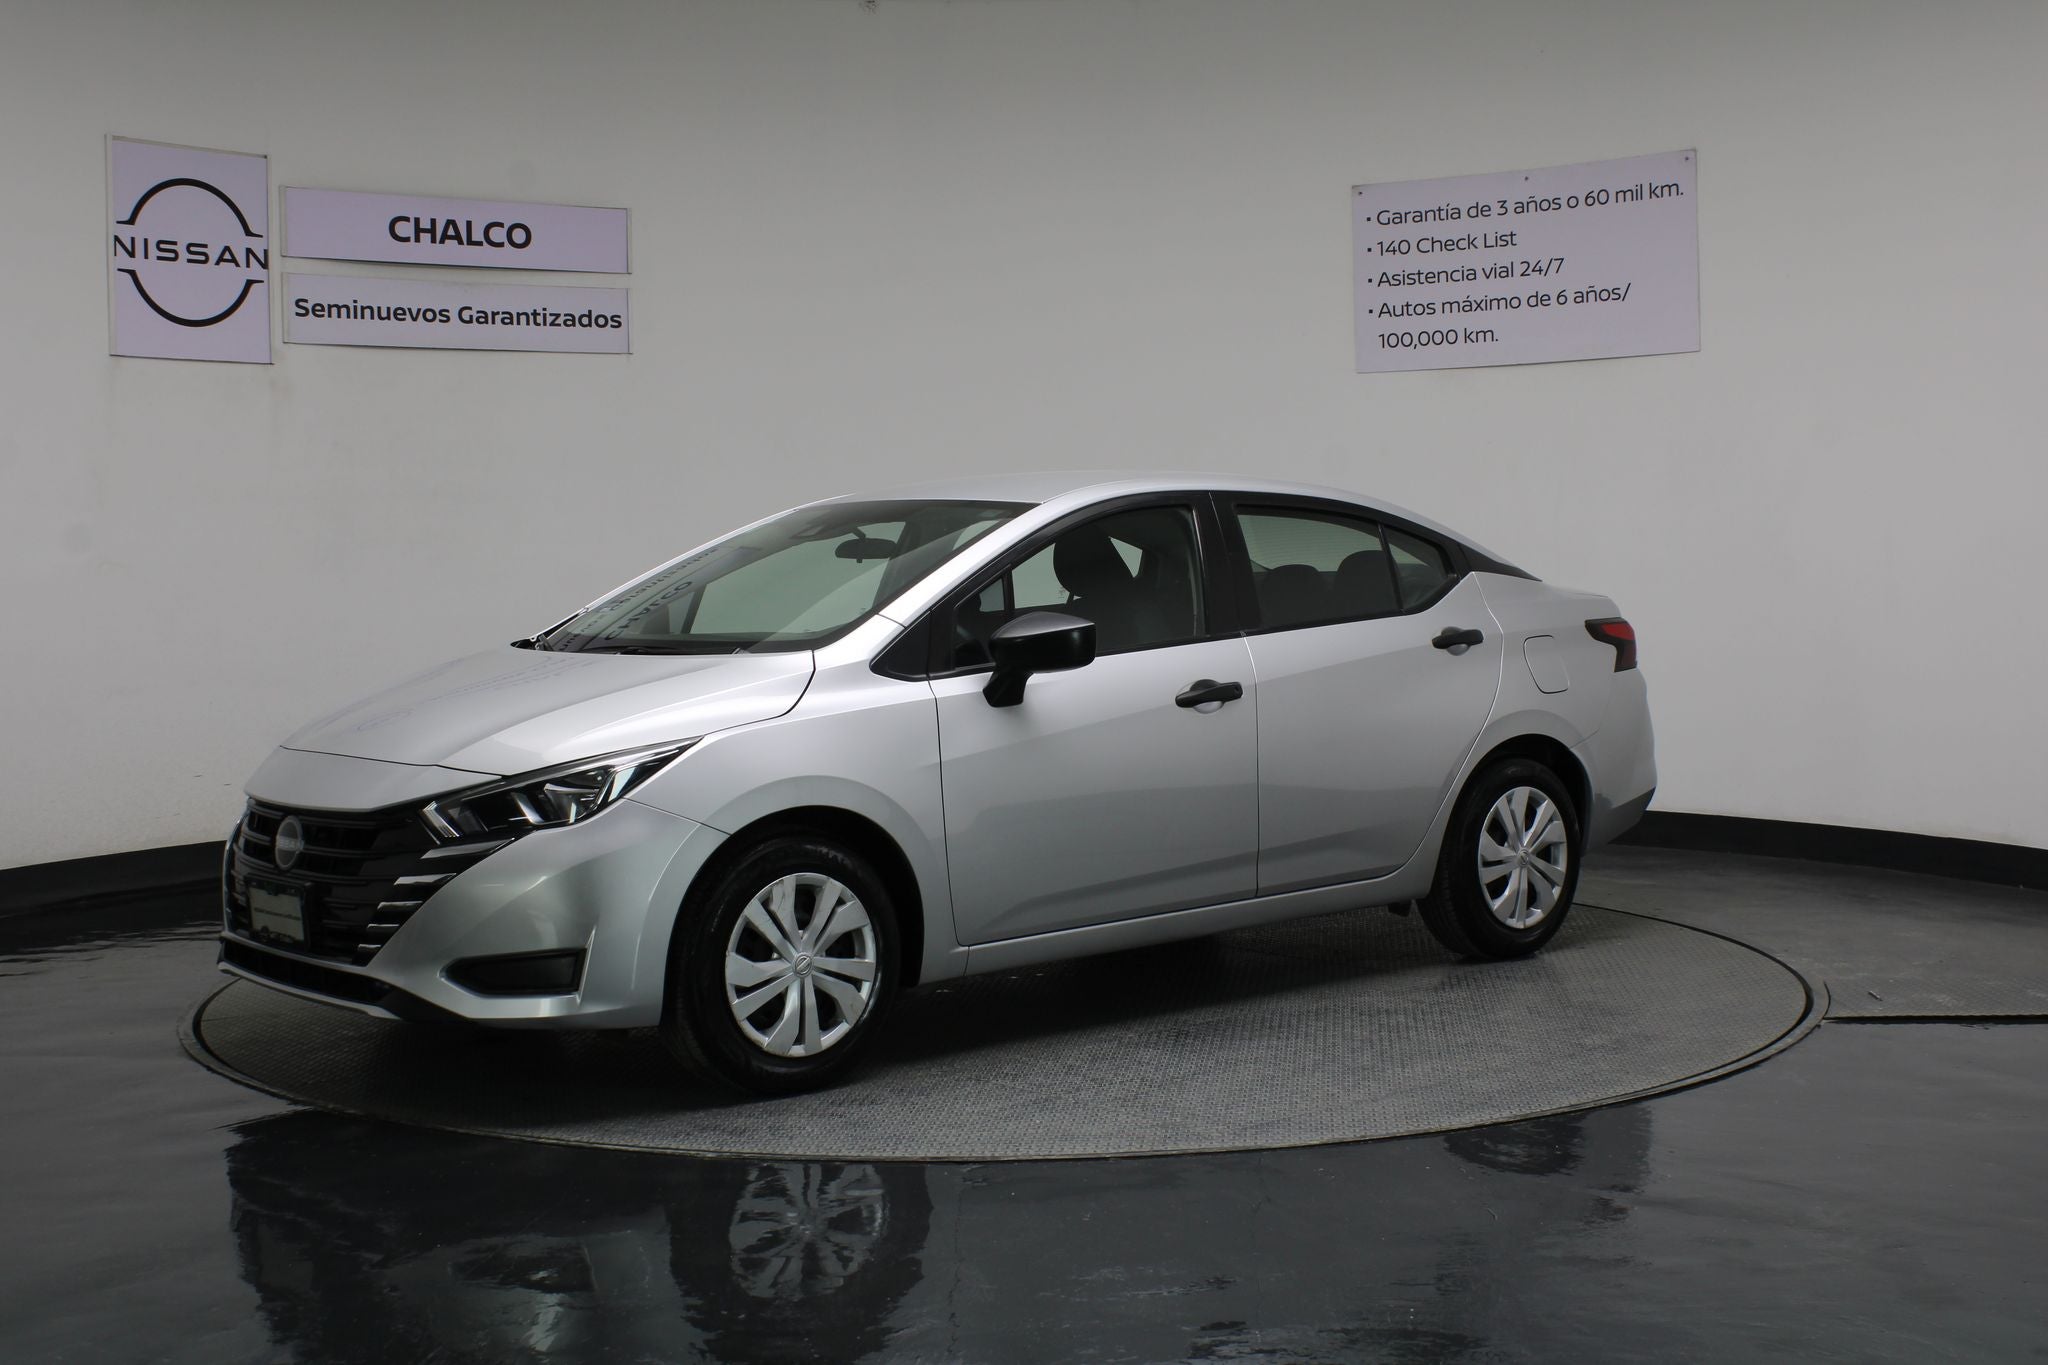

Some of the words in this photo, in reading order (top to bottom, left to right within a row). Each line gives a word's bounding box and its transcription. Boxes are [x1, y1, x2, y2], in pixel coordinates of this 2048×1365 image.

[1377, 203, 1461, 225] Garantía
[1467, 202, 1491, 218] de
[1497, 200, 1508, 216] 3
[1514, 196, 1561, 214] años
[1567, 196, 1579, 208] o
[1585, 189, 1609, 206] 60
[1616, 184, 1643, 203] mil
[1649, 183, 1683, 199] km.
[389, 216, 532, 249] CHALCO
[1377, 240, 1410, 256] 140
[1417, 234, 1478, 253] Check
[1484, 231, 1517, 248] List
[113, 234, 269, 270] NISSAN
[1378, 266, 1476, 287] Asistencia
[1482, 262, 1513, 279] vial
[1520, 258, 1564, 276] 24/7
[295, 298, 450, 323] Seminuevos
[458, 306, 622, 328] Garantizados
[1378, 302, 1436, 318] Autos
[1442, 296, 1521, 314] máximo
[1527, 291, 1551, 307] de
[1557, 290, 1567, 305] 6
[1574, 283, 1631, 304] años/
[1379, 329, 1458, 349] 100,000
[1464, 328, 1498, 343] km.
